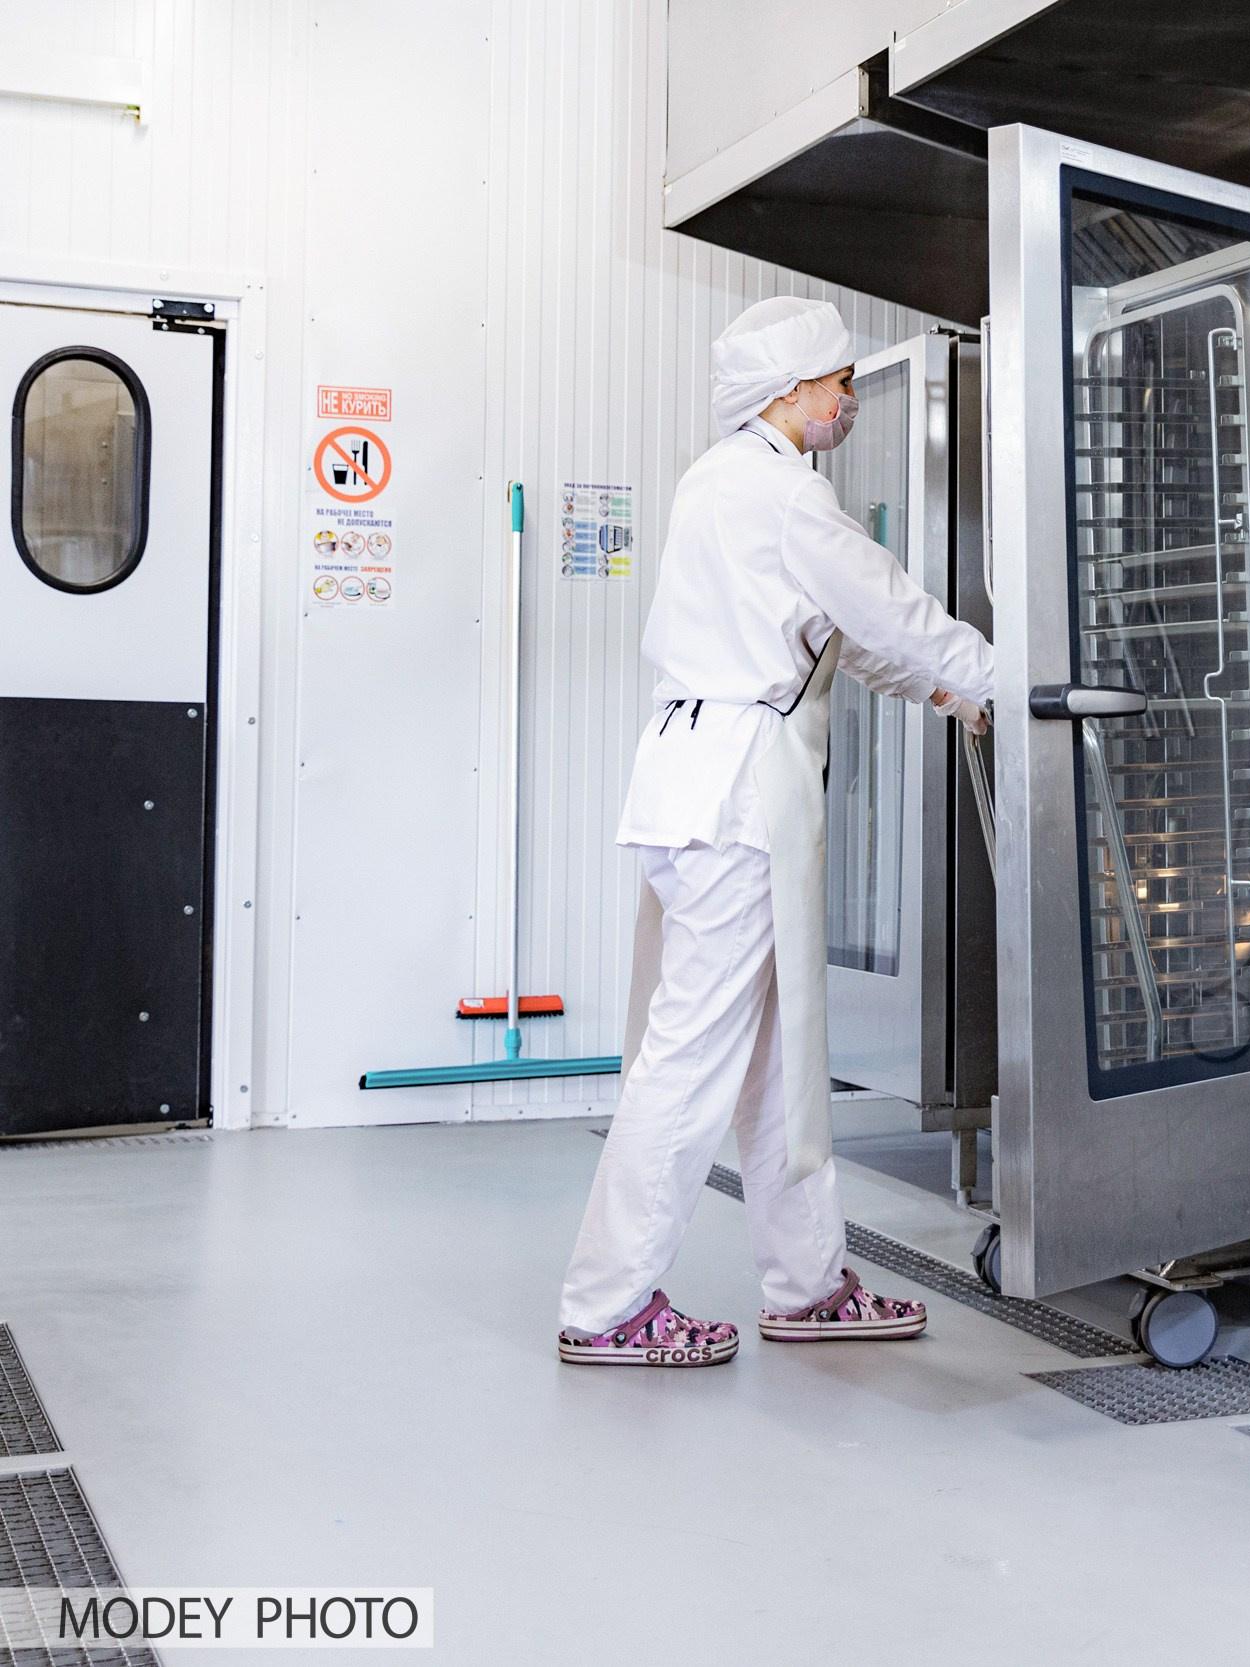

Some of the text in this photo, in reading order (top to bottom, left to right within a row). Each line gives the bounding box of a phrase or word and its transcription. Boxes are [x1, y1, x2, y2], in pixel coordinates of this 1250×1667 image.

[353, 393, 386, 402] SMOKING
[322, 391, 387, 416] НЕ КУРИТЬ
[353, 510, 374, 518] МЕСТО
[346, 518, 392, 527] ДОПУСКАЮТСЯ
[646, 1346, 712, 1363] crocs
